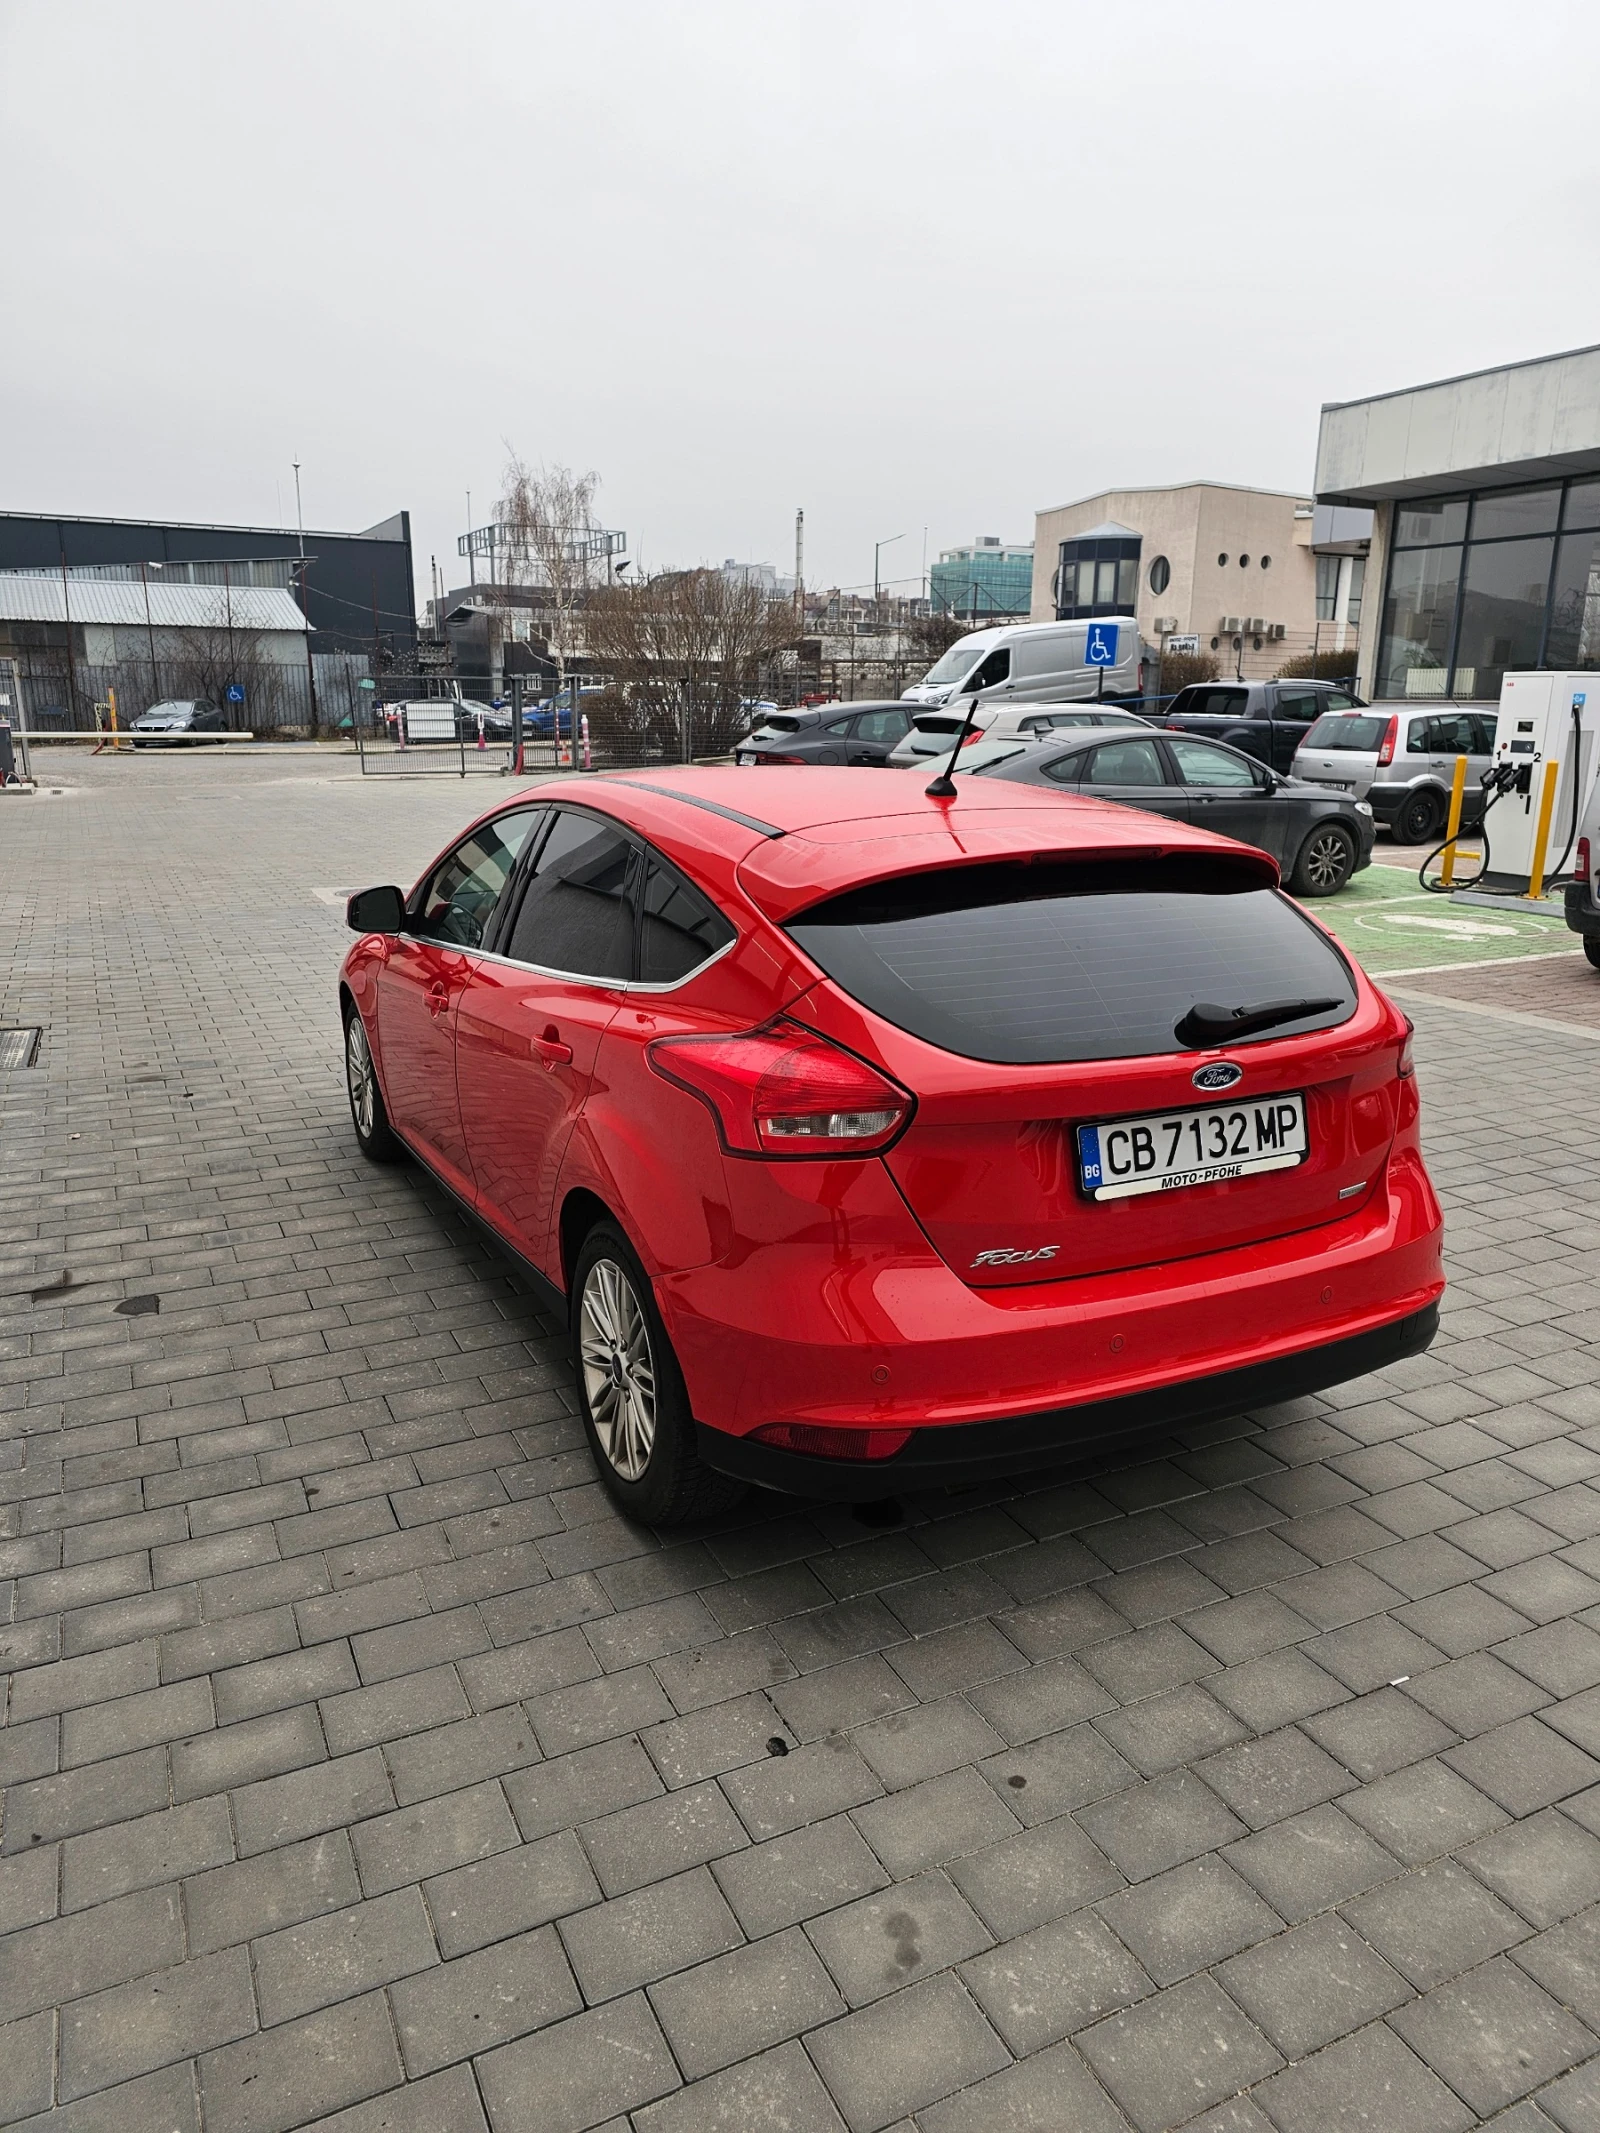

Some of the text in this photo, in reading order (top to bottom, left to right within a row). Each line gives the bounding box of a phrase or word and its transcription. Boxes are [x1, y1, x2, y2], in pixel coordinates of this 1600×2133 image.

[1496, 751, 1502, 760] 1
[1533, 752, 1542, 762] 2
[1203, 1067, 1232, 1086] Ford
[1084, 1163, 1100, 1179] BG
